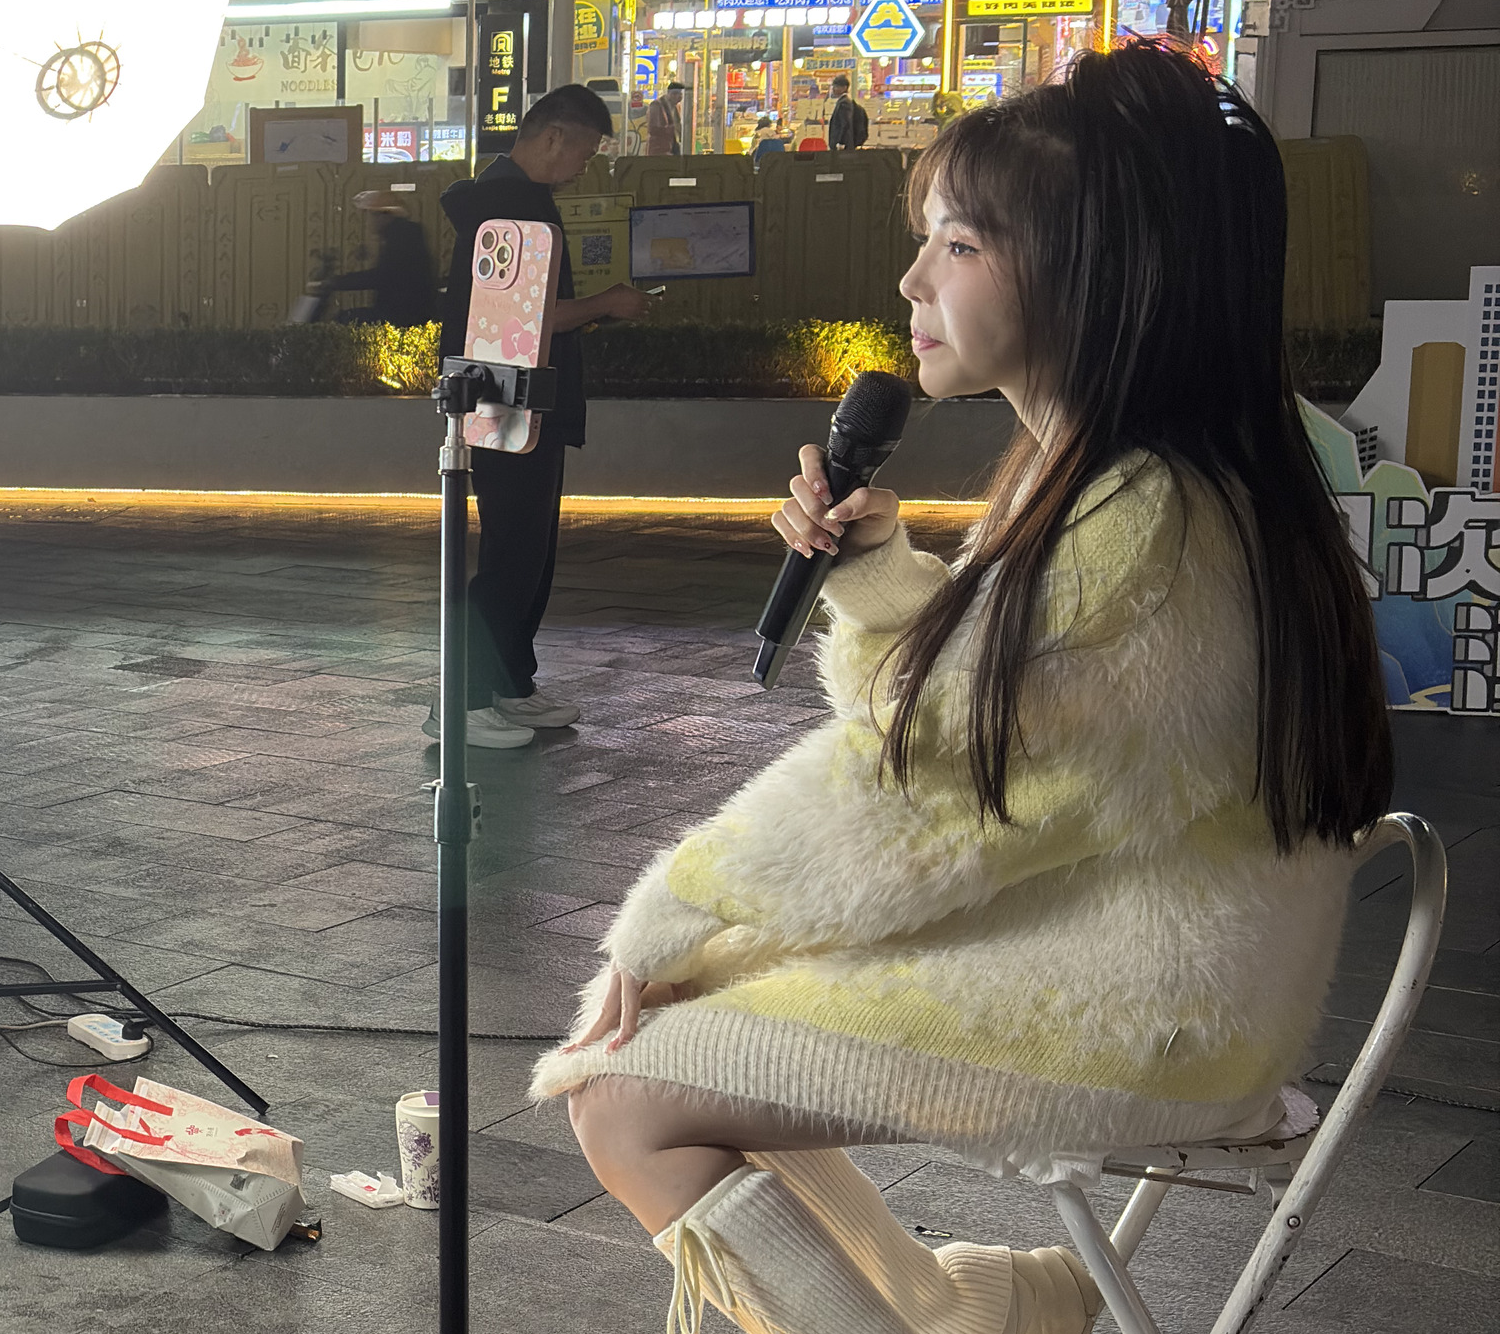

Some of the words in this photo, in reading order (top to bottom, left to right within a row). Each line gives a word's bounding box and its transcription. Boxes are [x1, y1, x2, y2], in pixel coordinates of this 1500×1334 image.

[489, 55, 514, 69] 地铁
[492, 86, 510, 111] F
[484, 113, 517, 125] 老街站
